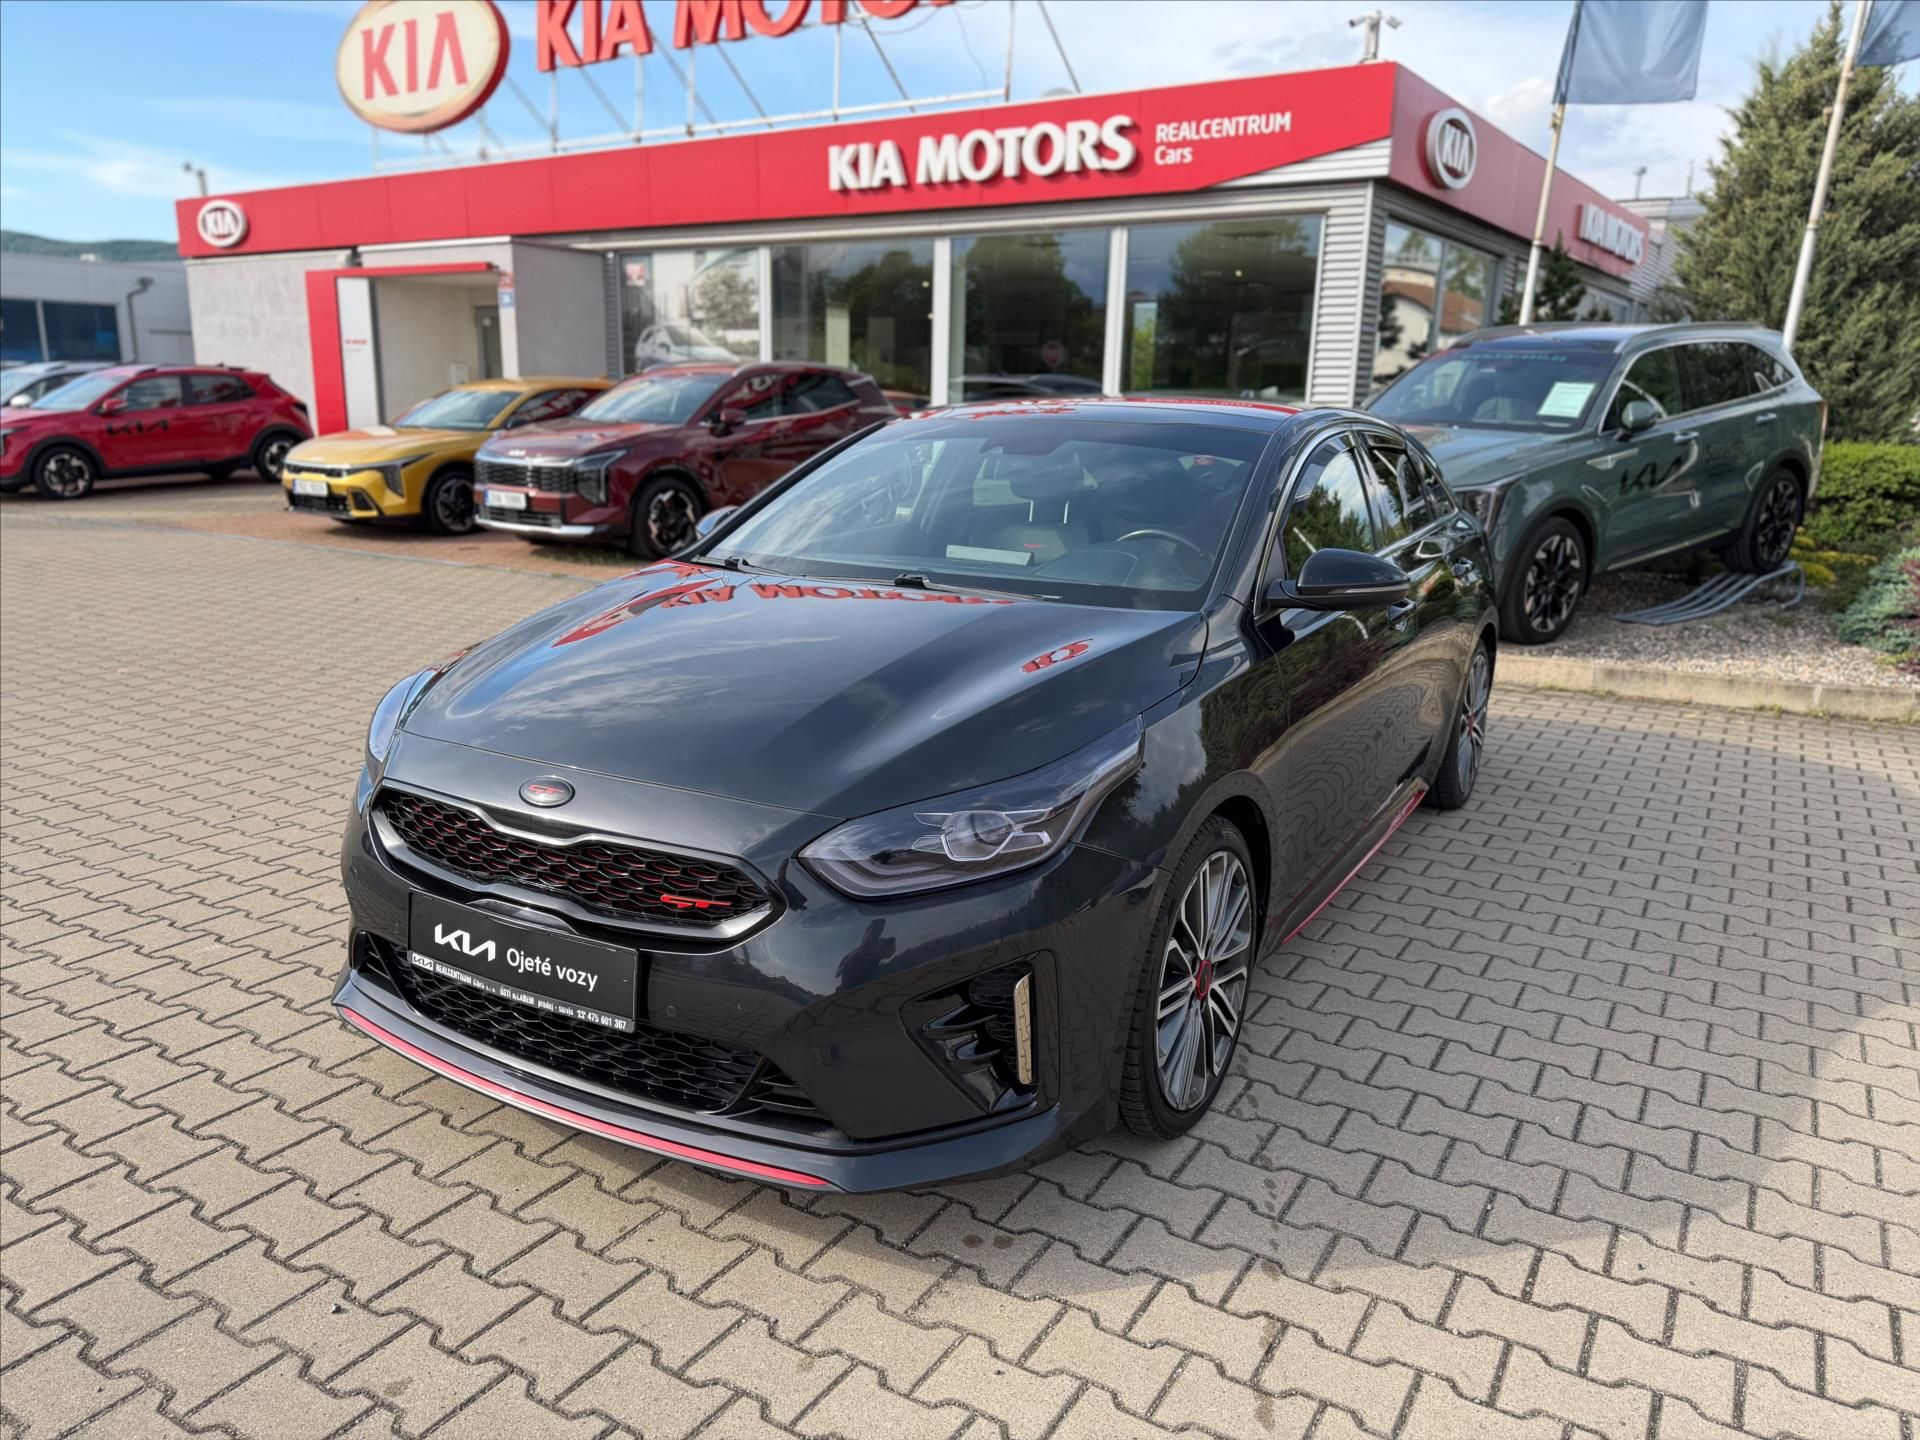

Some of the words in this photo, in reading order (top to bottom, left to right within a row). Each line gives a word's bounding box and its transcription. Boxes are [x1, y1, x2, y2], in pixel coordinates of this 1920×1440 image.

[361, 11, 469, 100] KIA
[536, 0, 653, 71] KIA
[828, 139, 906, 191] KIA
[916, 115, 1137, 184] MOTORS
[1154, 145, 1193, 165] Cars
[1155, 111, 1292, 143] REALCENTRUM
[1441, 122, 1470, 175] KIA
[205, 209, 237, 237] KIA
[659, 894, 733, 909] GT
[434, 923, 496, 962] KIA
[506, 947, 551, 976] Ojeté
[556, 964, 598, 992] vozy
[435, 963, 472, 984] REALCENTRUM
[587, 1012, 600, 1023] 475
[601, 1015, 612, 1026] 601
[614, 1018, 627, 1030] 367
